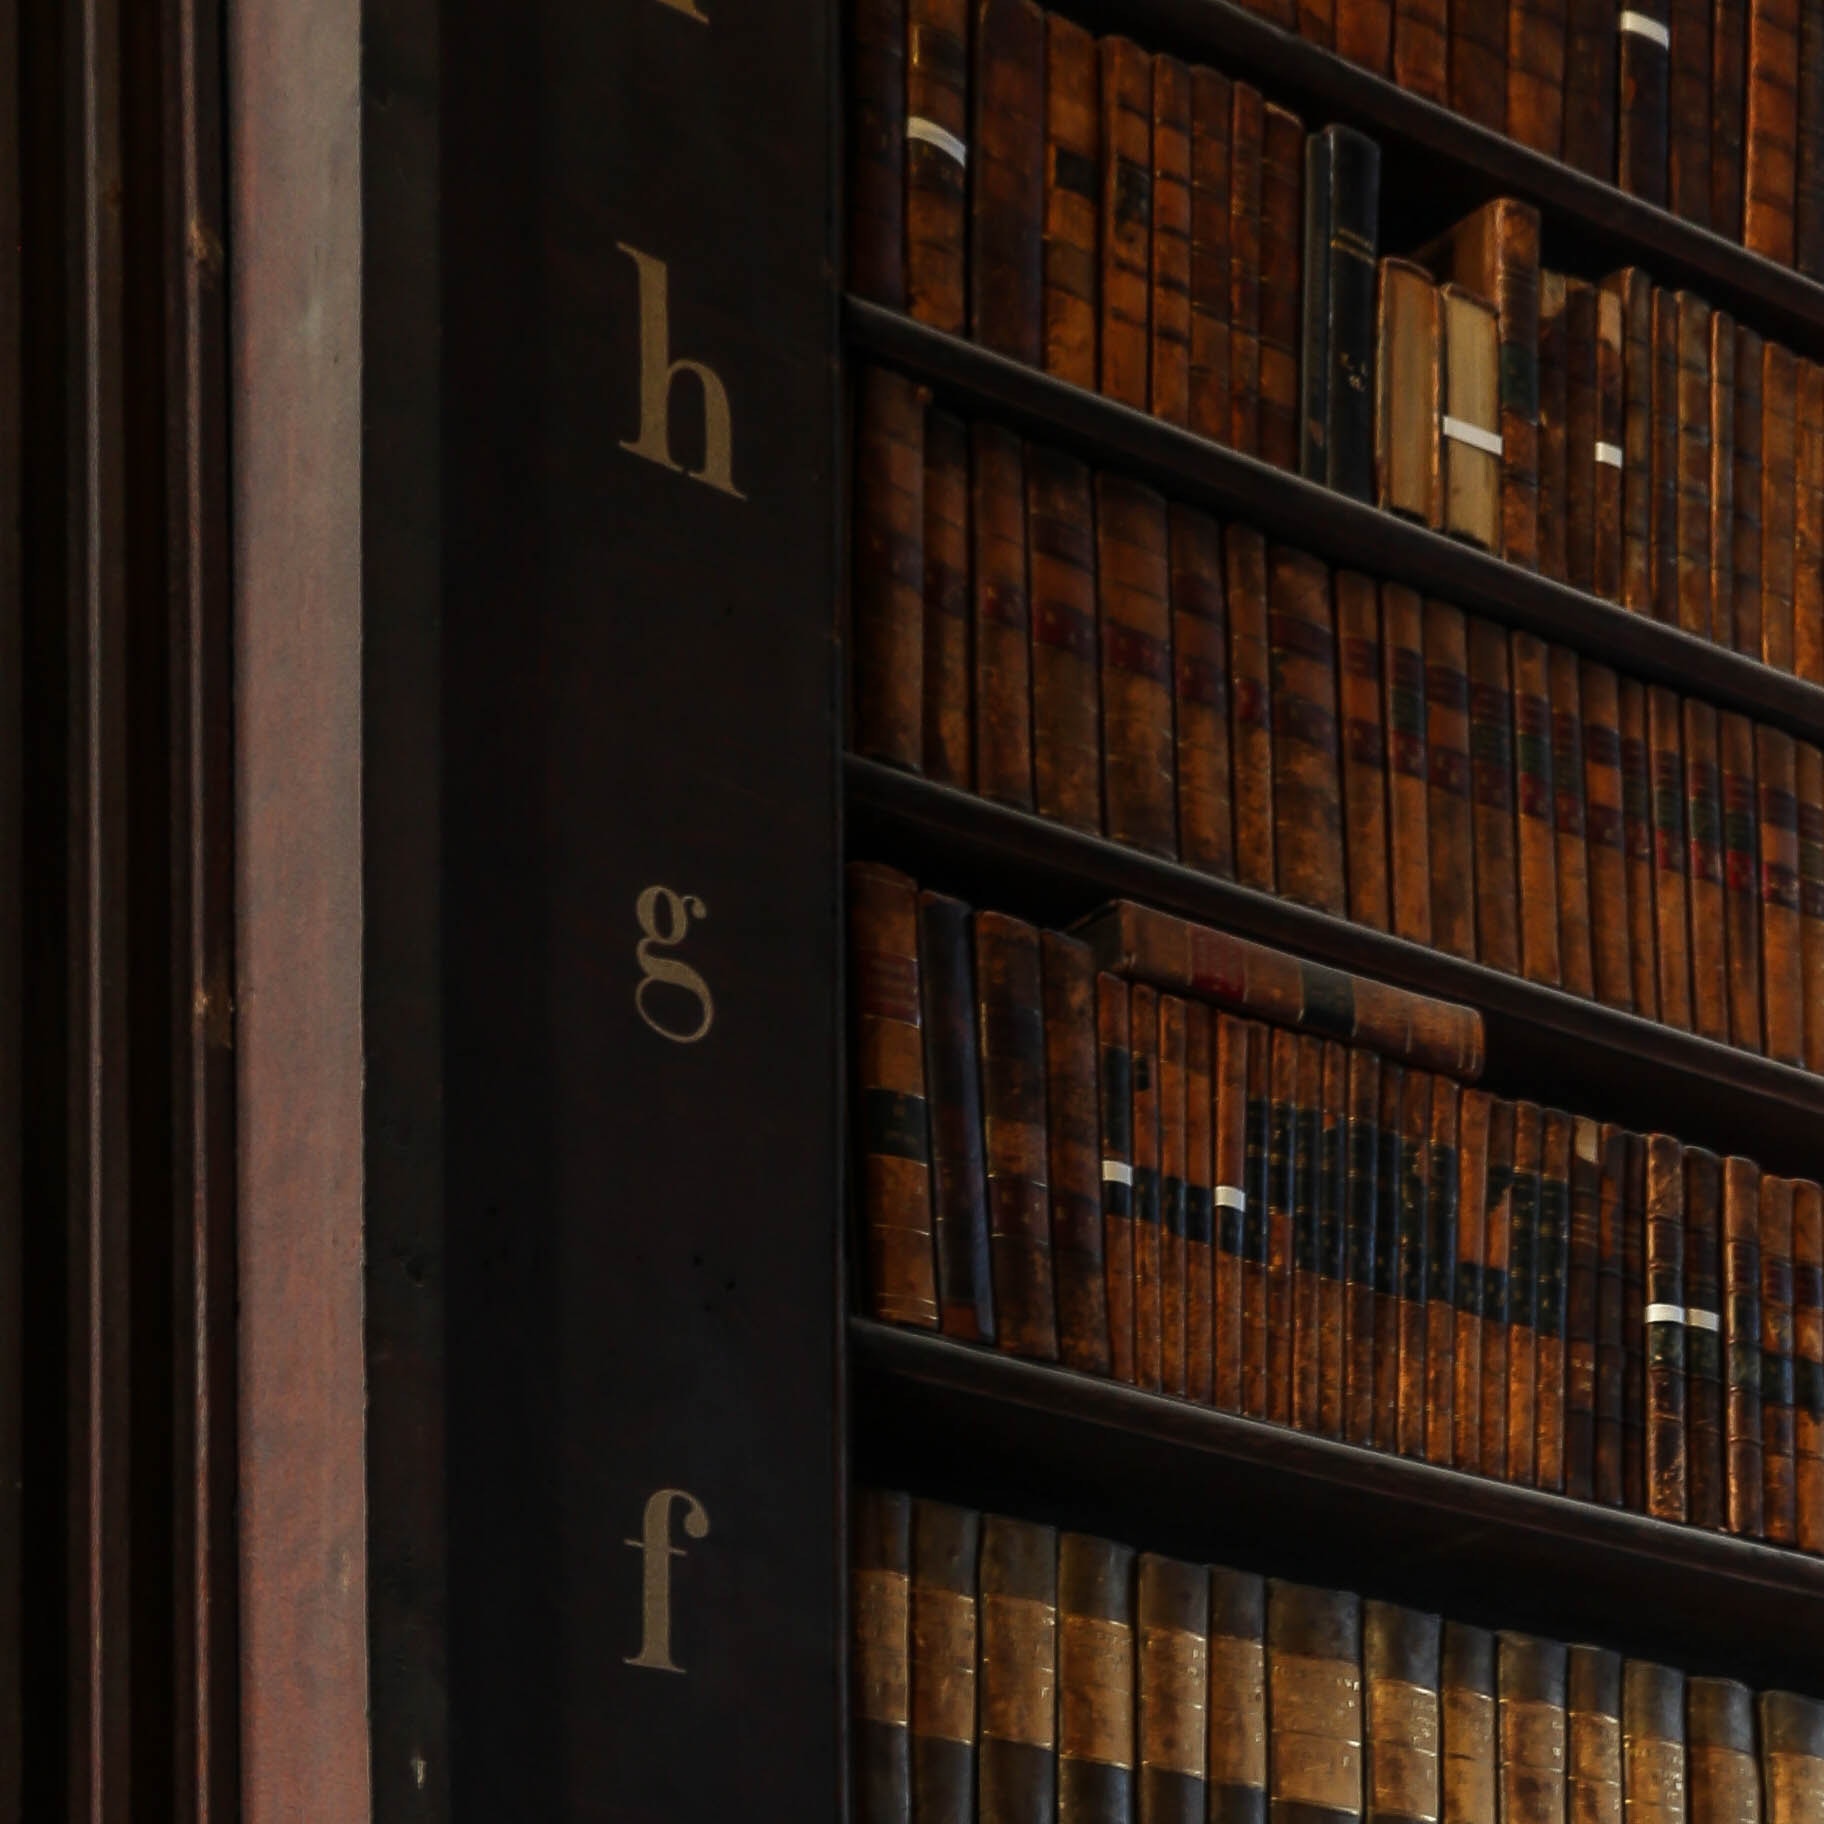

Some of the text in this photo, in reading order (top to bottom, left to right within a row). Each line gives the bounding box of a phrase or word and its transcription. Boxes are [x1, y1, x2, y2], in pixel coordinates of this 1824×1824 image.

[617, 241, 746, 500] h
[635, 884, 715, 1044] g
[624, 1487, 710, 1674] f
